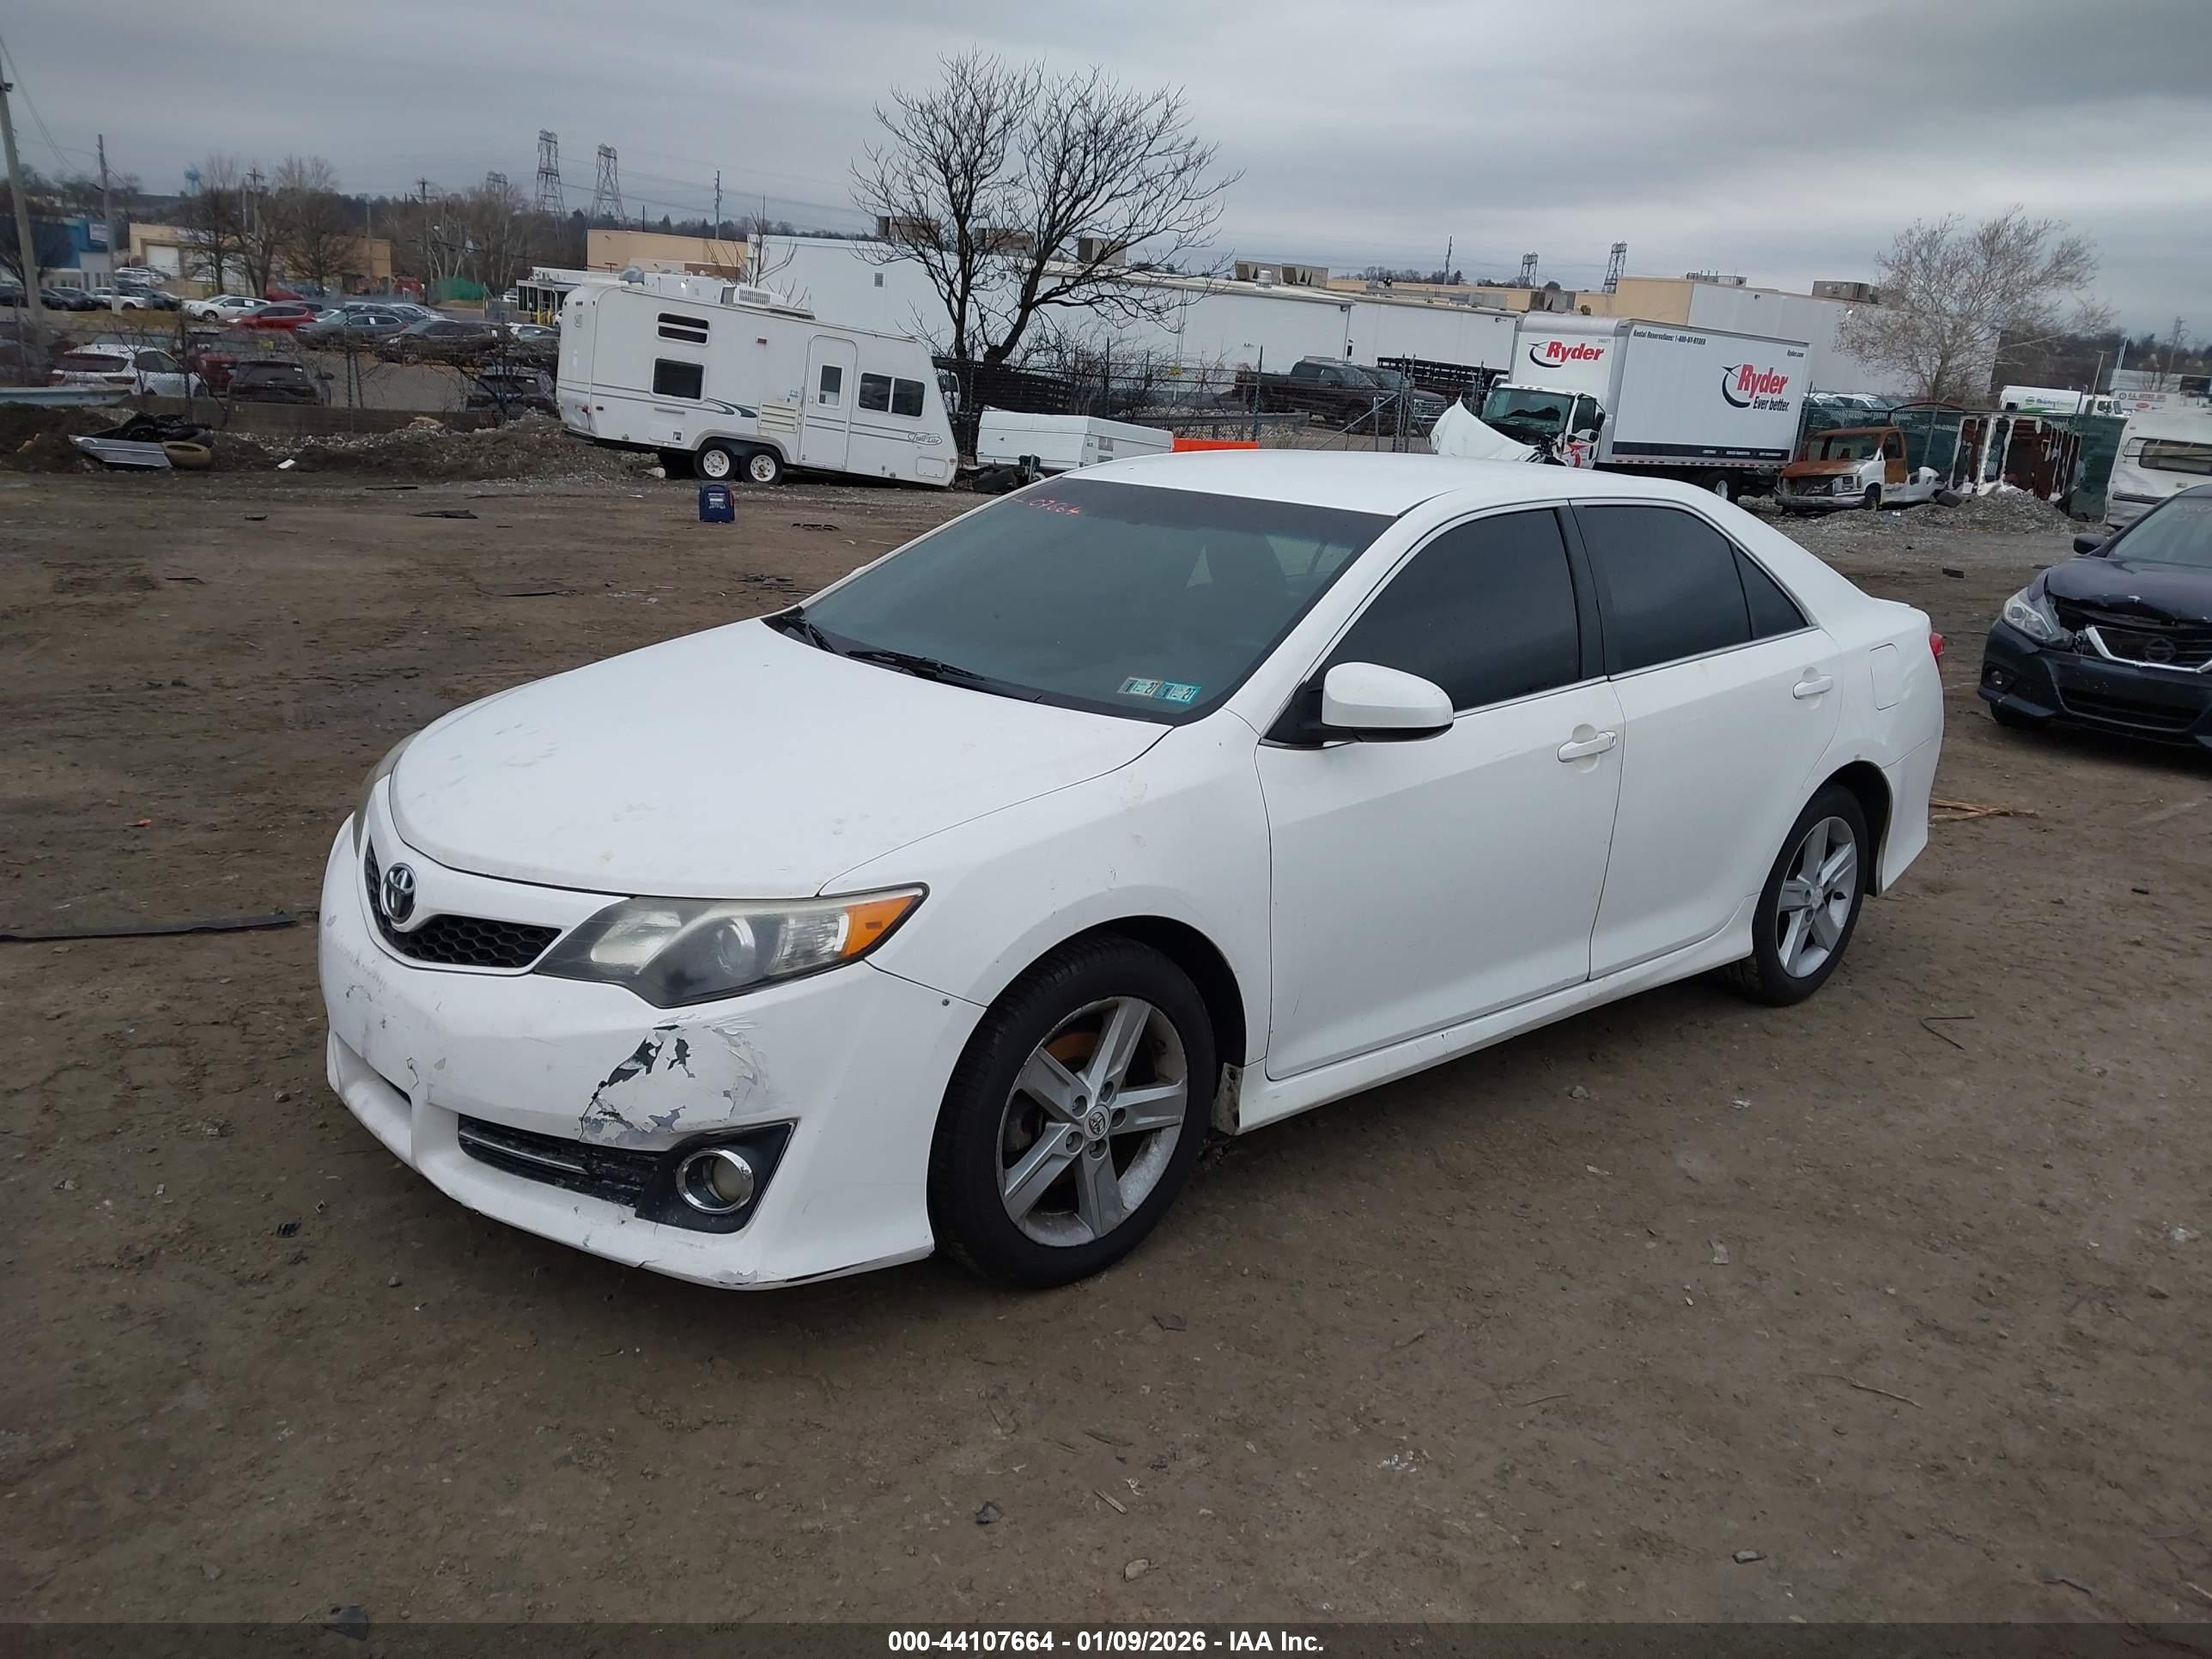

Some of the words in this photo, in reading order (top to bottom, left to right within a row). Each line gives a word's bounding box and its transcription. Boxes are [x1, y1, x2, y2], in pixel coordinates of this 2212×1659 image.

[1546, 341, 1605, 362] Ryder
[1737, 363, 1790, 398] Ryder
[1753, 396, 1769, 410] Ever
[1769, 398, 1790, 412] better.
